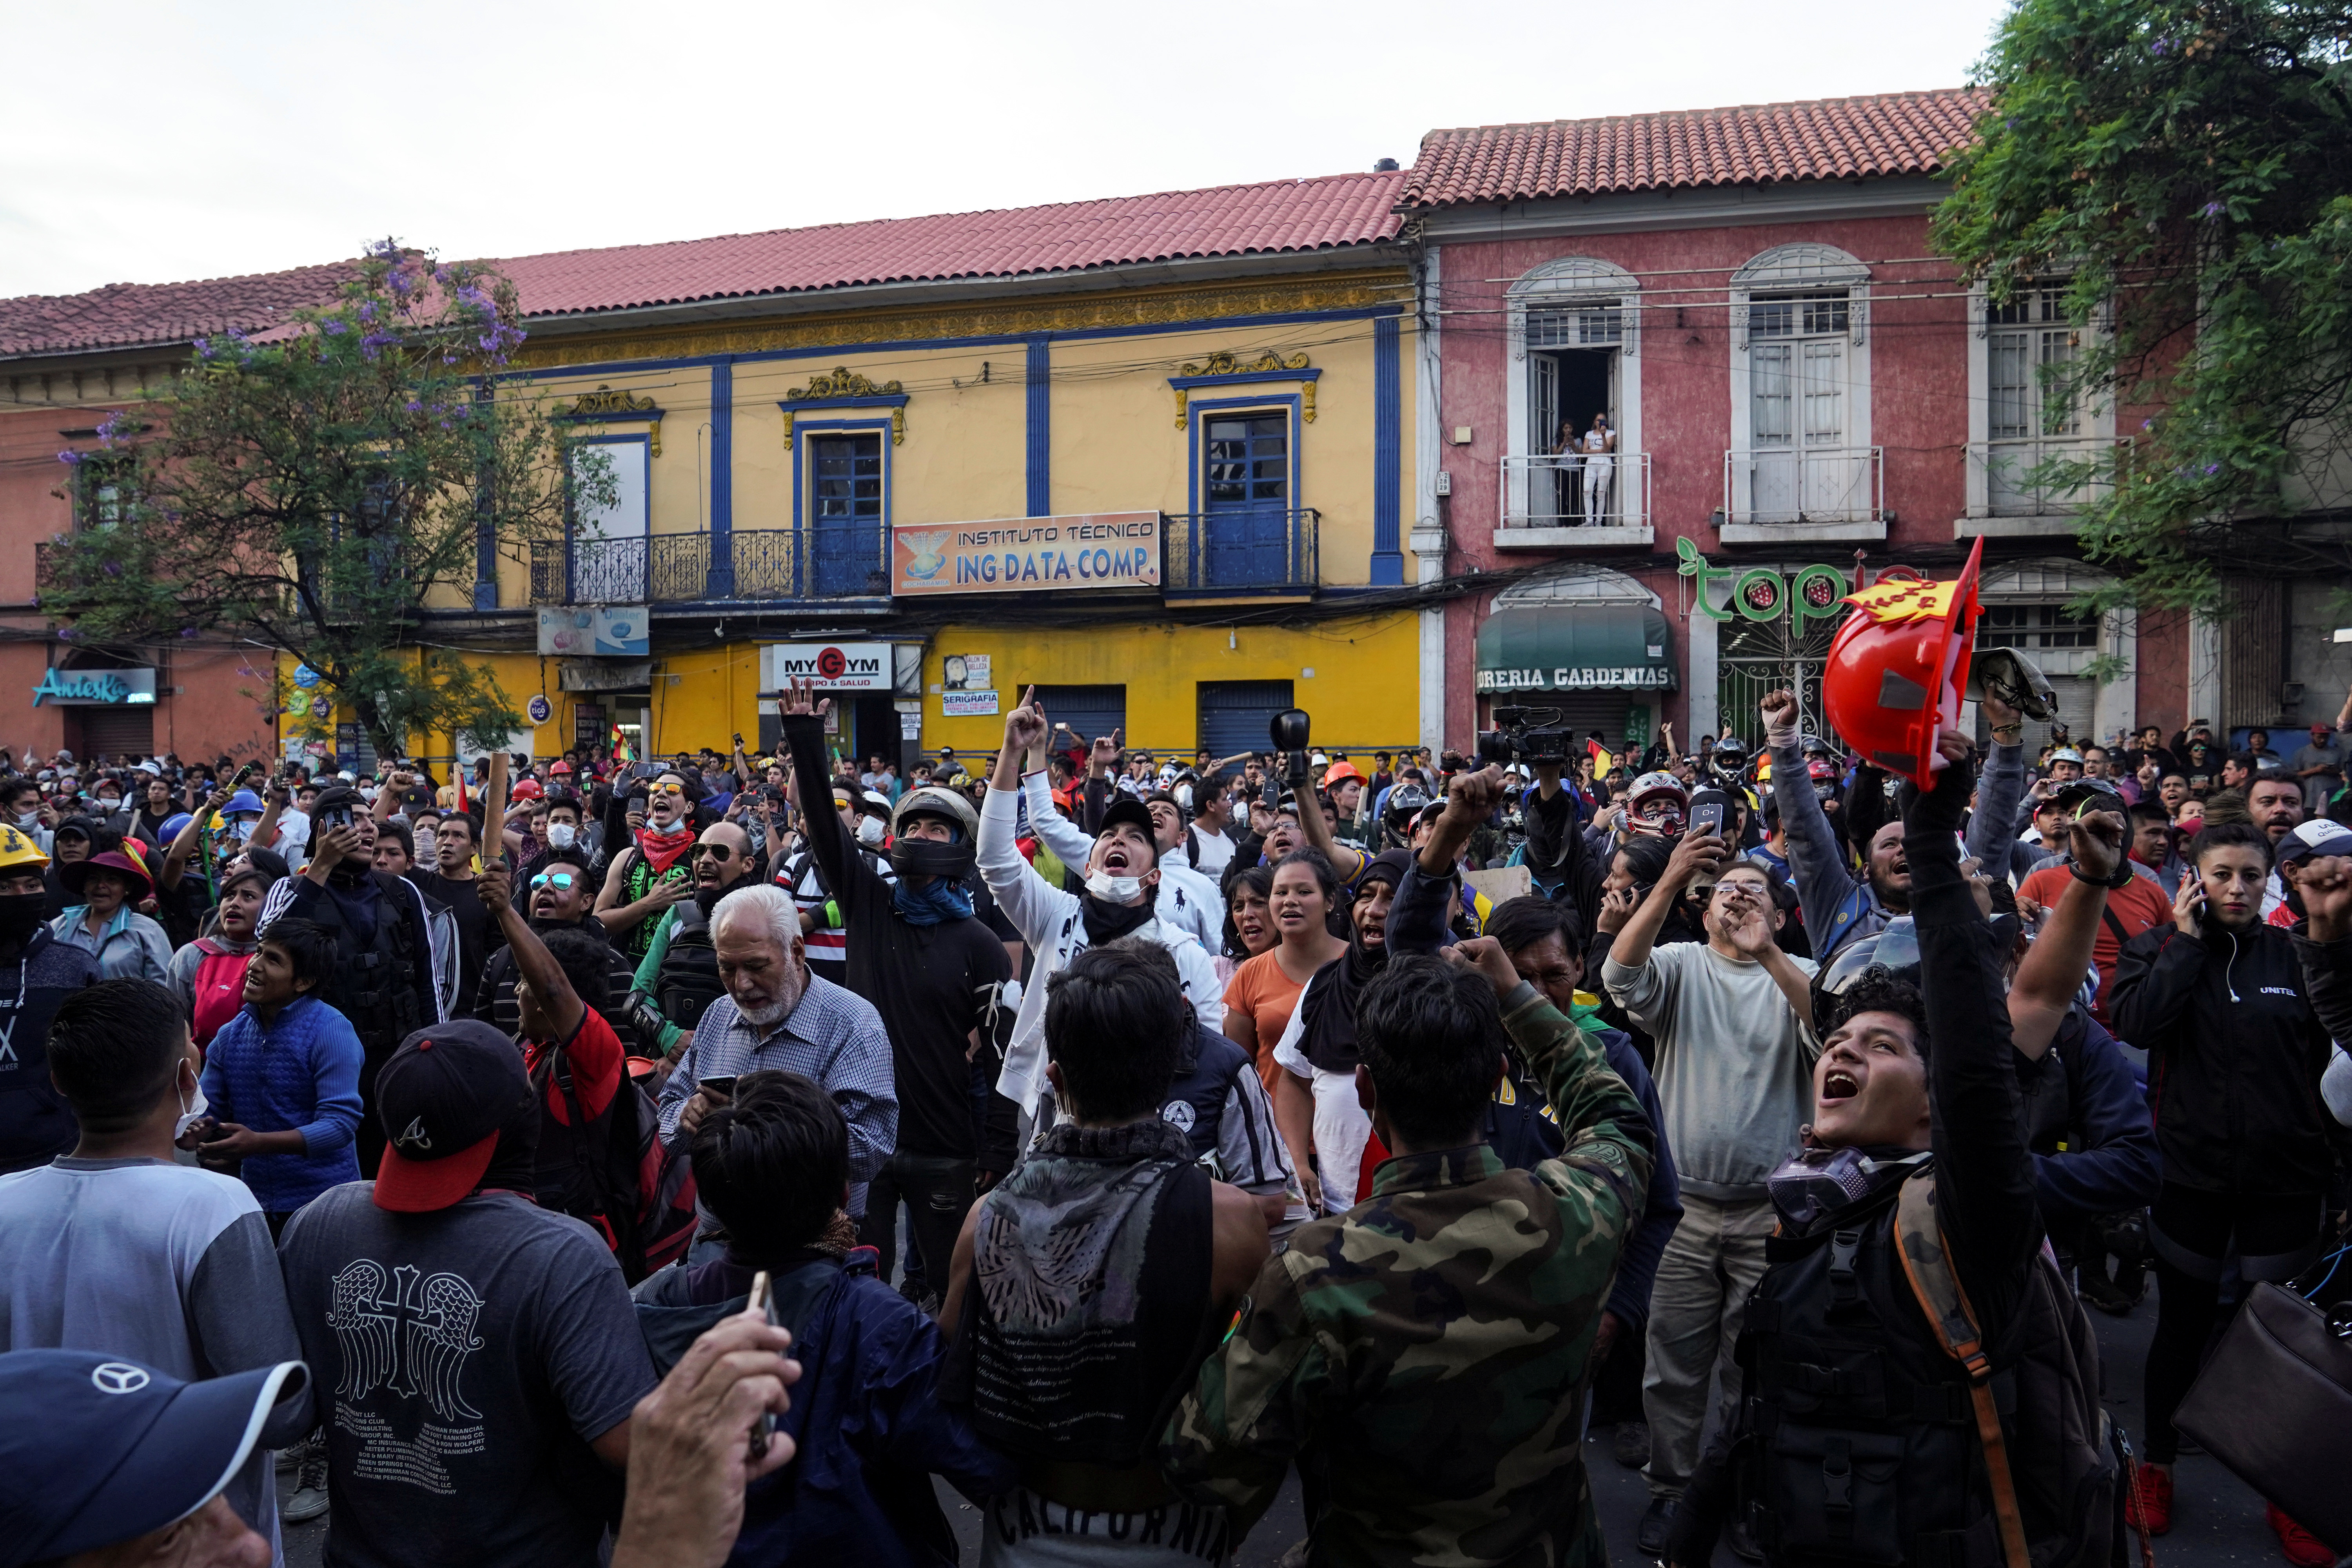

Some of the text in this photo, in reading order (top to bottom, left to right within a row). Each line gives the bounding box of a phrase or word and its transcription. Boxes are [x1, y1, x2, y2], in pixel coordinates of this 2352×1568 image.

[958, 527, 1058, 546] INSTITUTO
[1554, 667, 1668, 686] GARDENIAS
[944, 694, 997, 703] SERIGRAFIA
[2260, 987, 2297, 996] UNITEL
[449, 1425, 484, 1434] FINANCIAL
[378, 1440, 411, 1448] INSURANCE
[454, 1437, 485, 1447] WOLPERT
[386, 1447, 415, 1455] PLUMBING
[404, 1463, 425, 1474] MASONIC
[425, 1470, 439, 1480] LODGE
[431, 1465, 447, 1474] FAMILY
[353, 1470, 457, 1494] PLATINUM PERFORMANCE PHOTOGRAPHY
